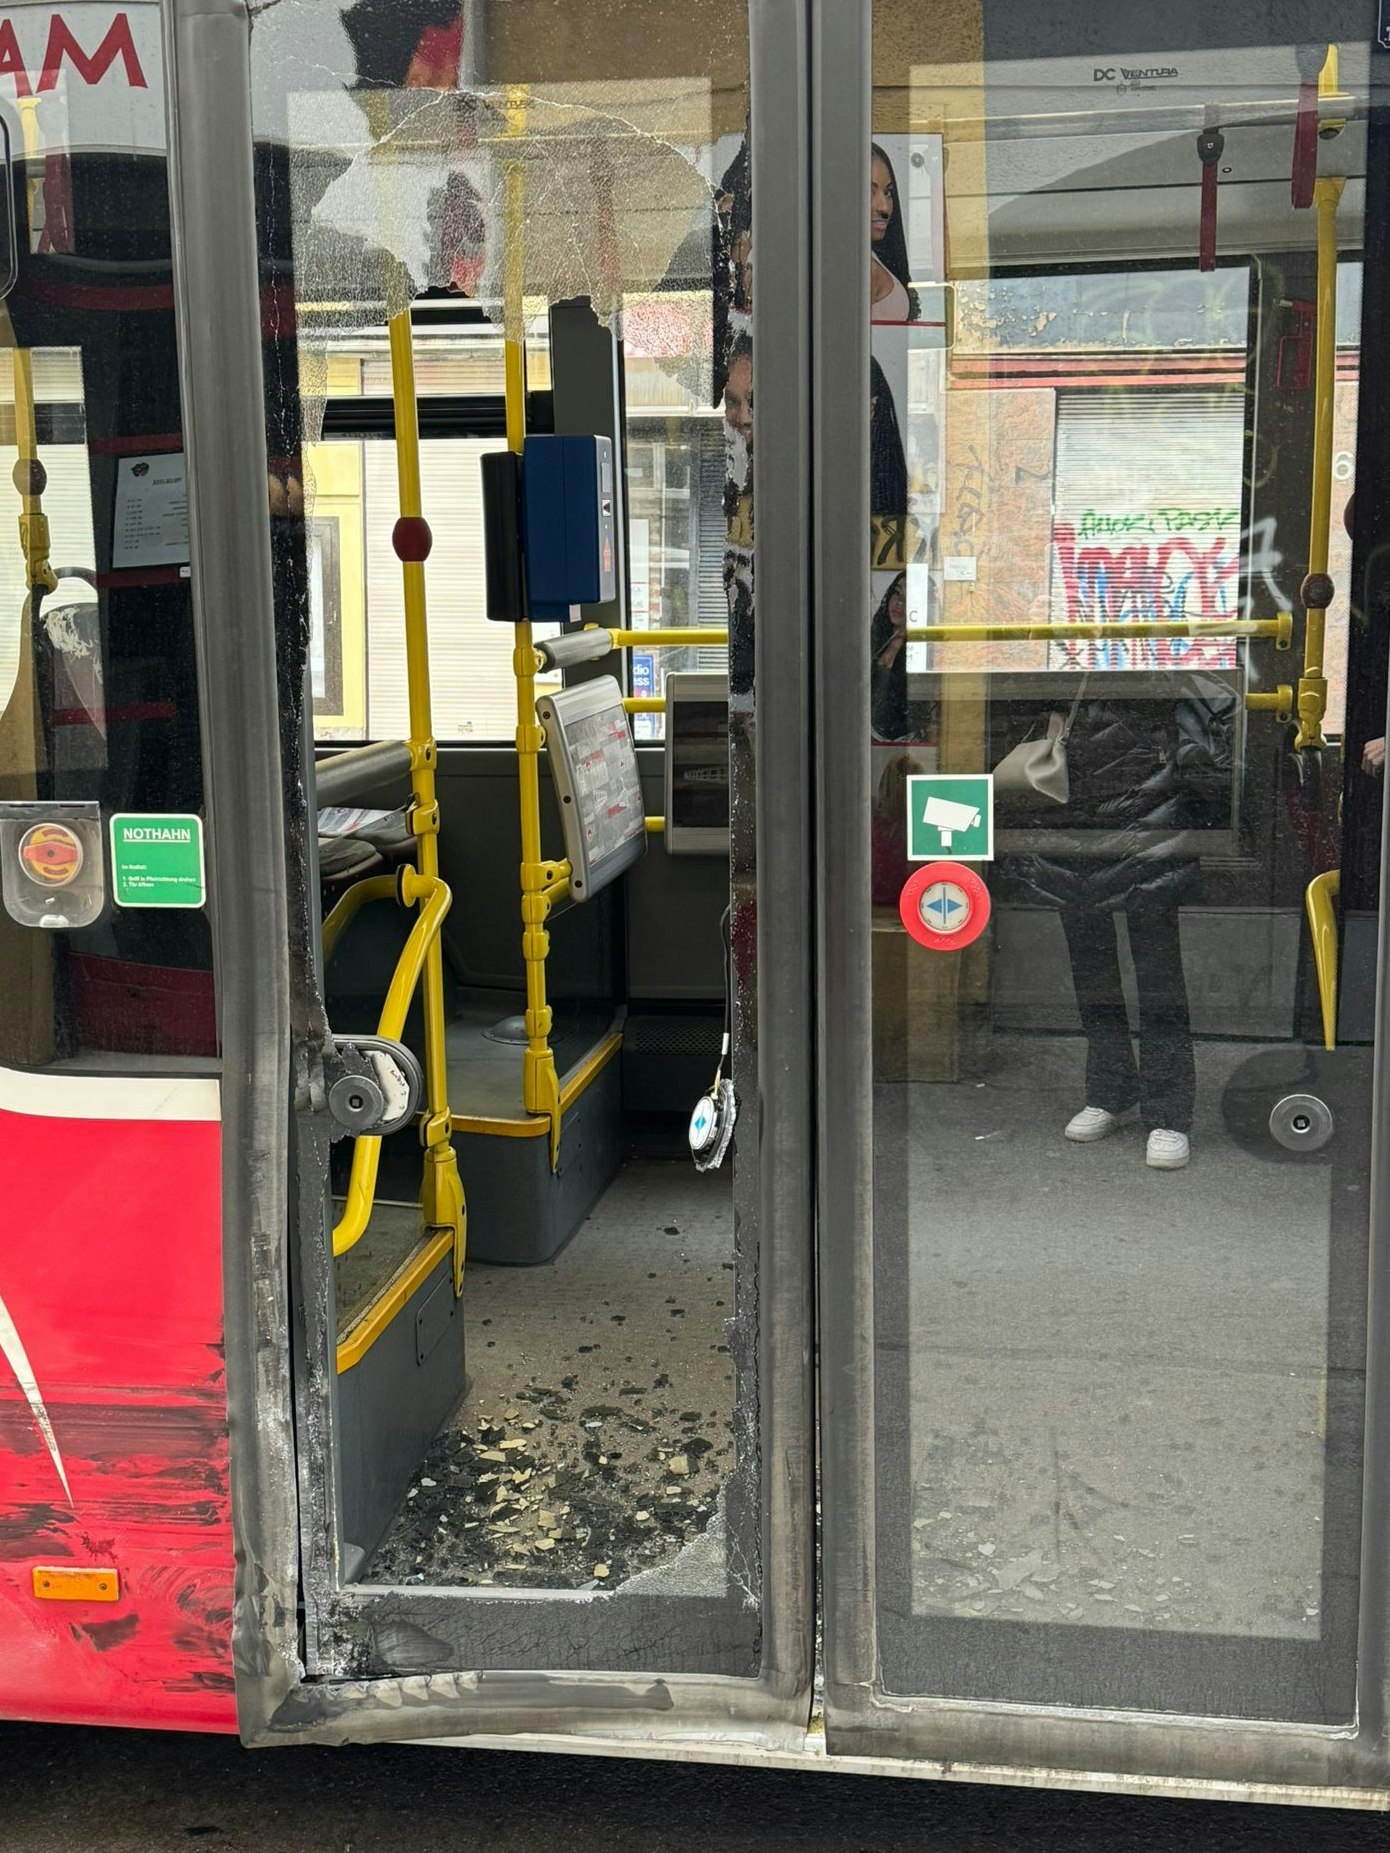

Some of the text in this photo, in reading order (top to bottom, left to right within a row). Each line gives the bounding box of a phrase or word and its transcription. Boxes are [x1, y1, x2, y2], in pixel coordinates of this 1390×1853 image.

[1093, 67, 1178, 81] DC VENTURA
[123, 828, 191, 840] NOTHAHN
